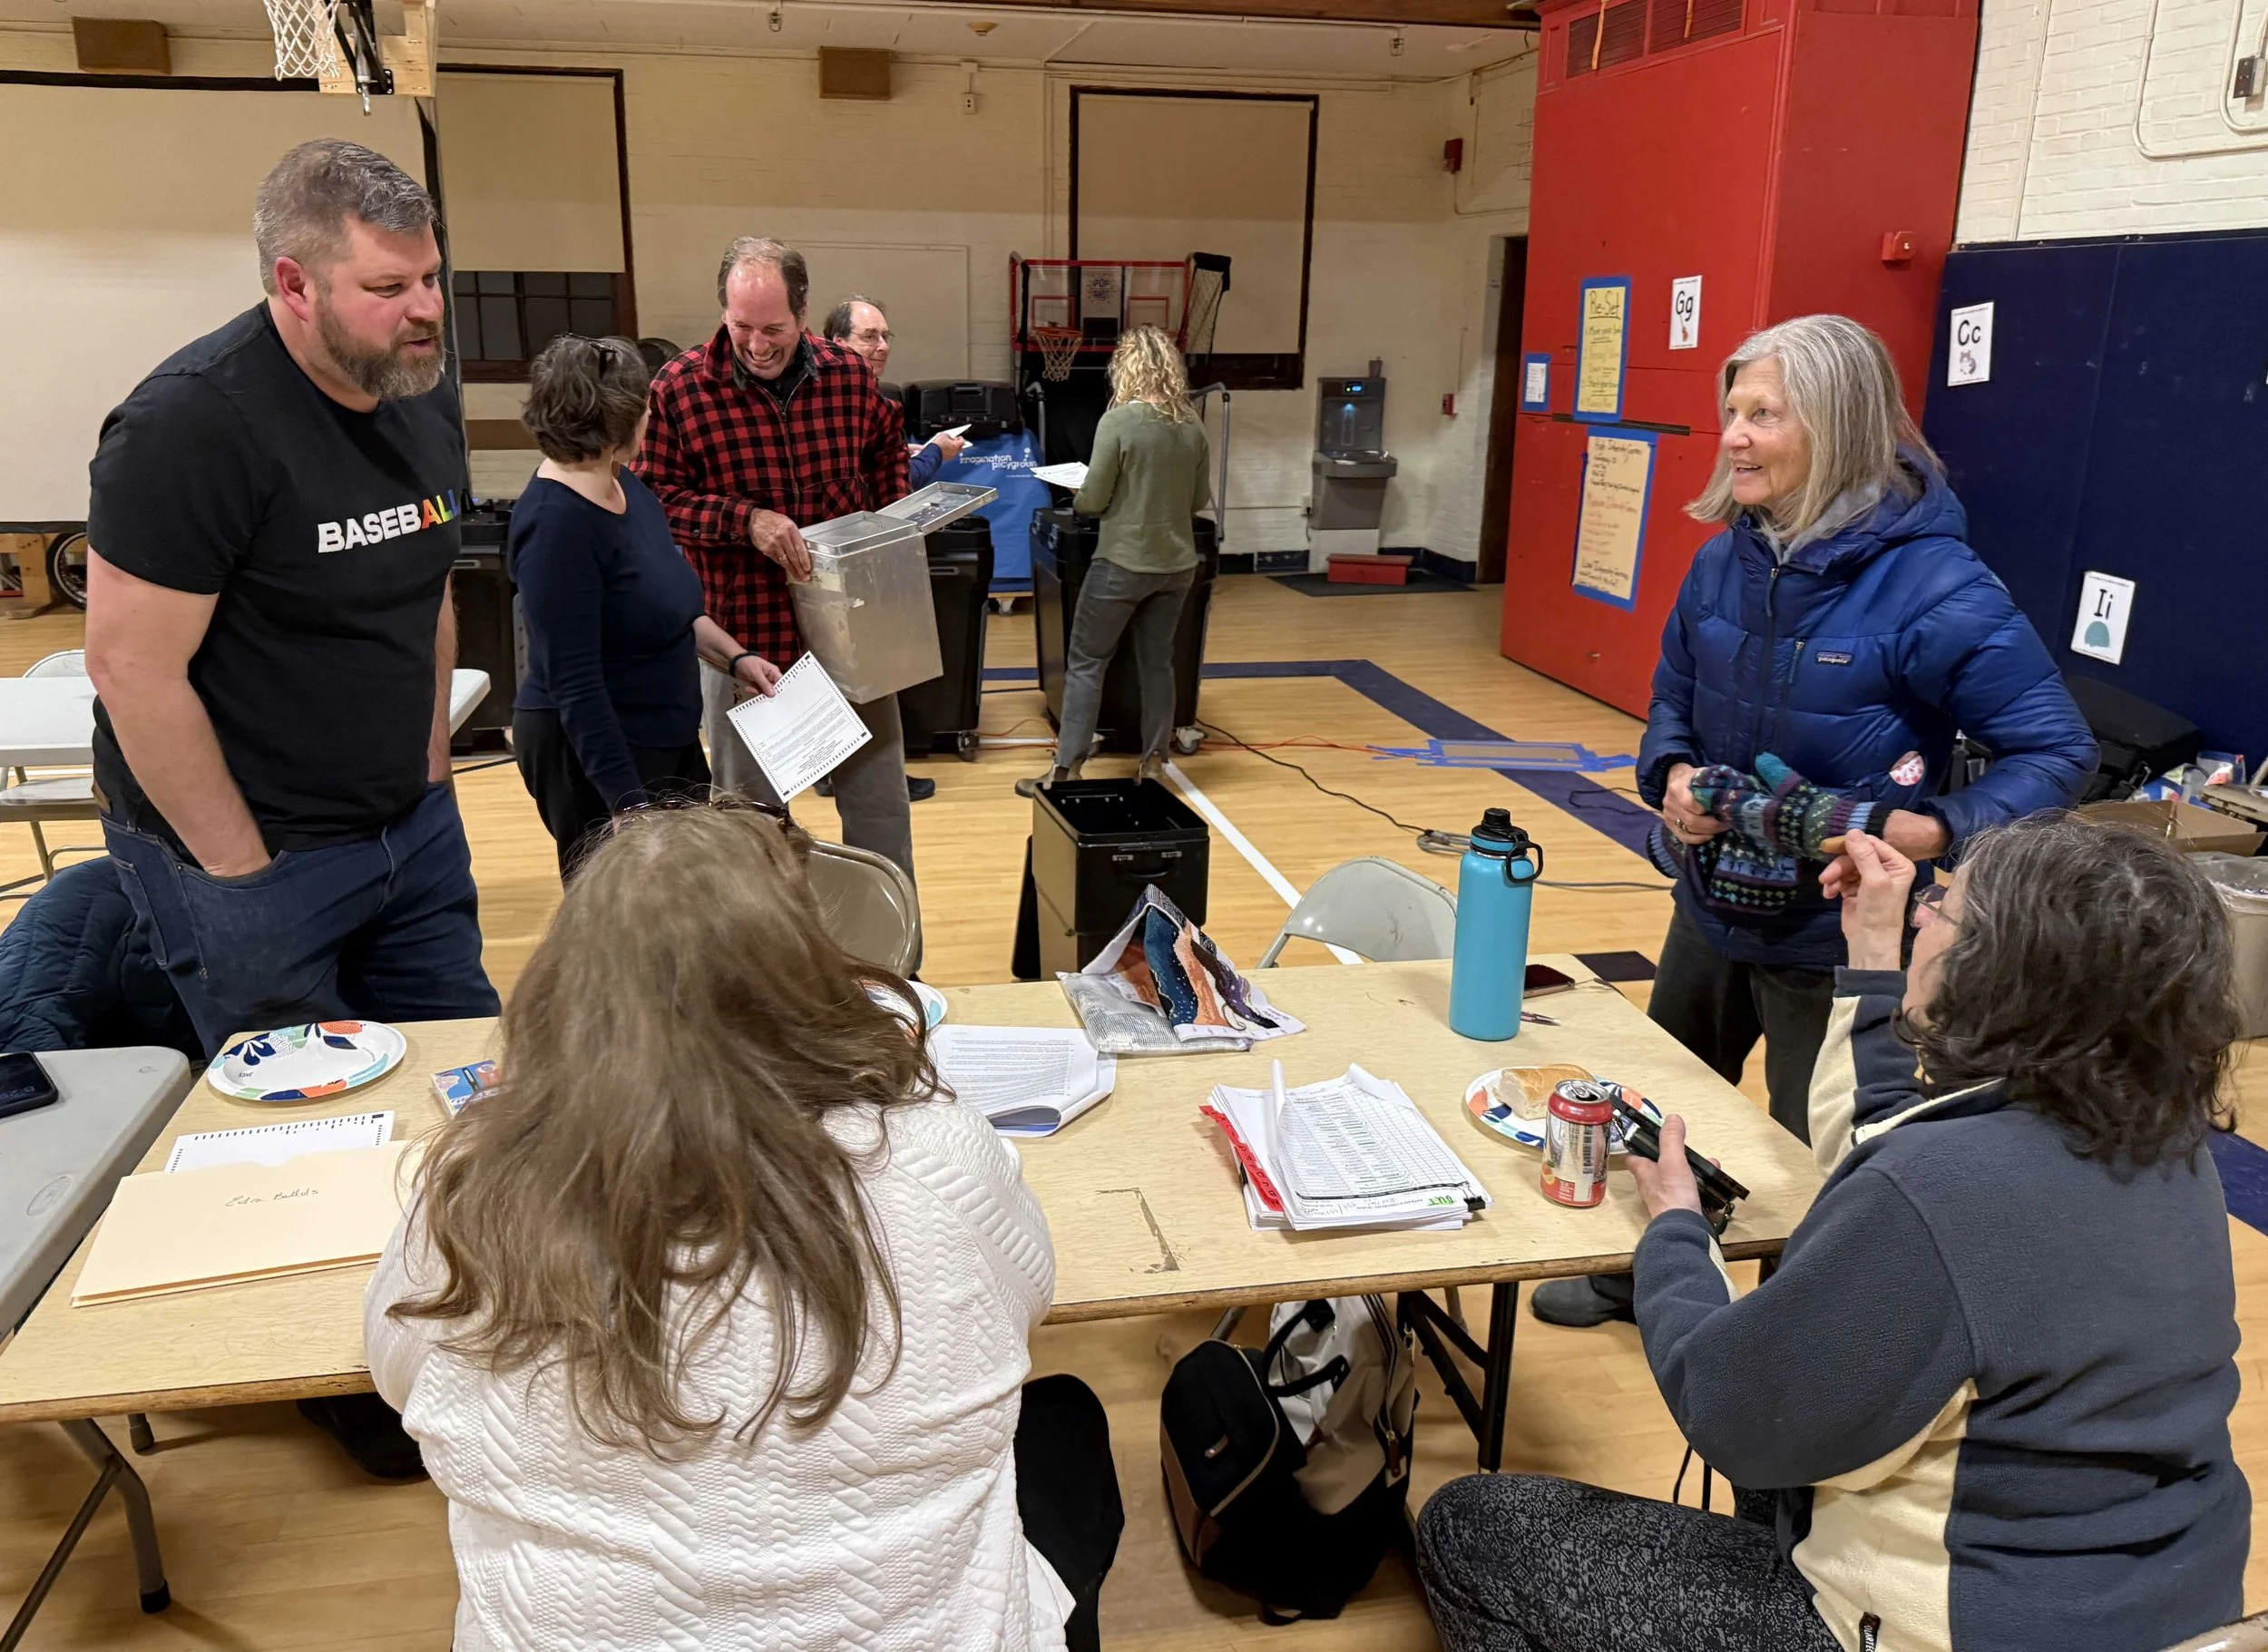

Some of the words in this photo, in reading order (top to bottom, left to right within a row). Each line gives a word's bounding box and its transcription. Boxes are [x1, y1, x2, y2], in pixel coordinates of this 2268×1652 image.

[1589, 290, 1620, 317] Re-Set
[1676, 290, 1694, 322] Gg
[1958, 319, 1981, 347] Cc
[992, 458, 1038, 470] playgroun
[318, 489, 460, 553] BASEBALL
[2094, 589, 2114, 620] Ii
